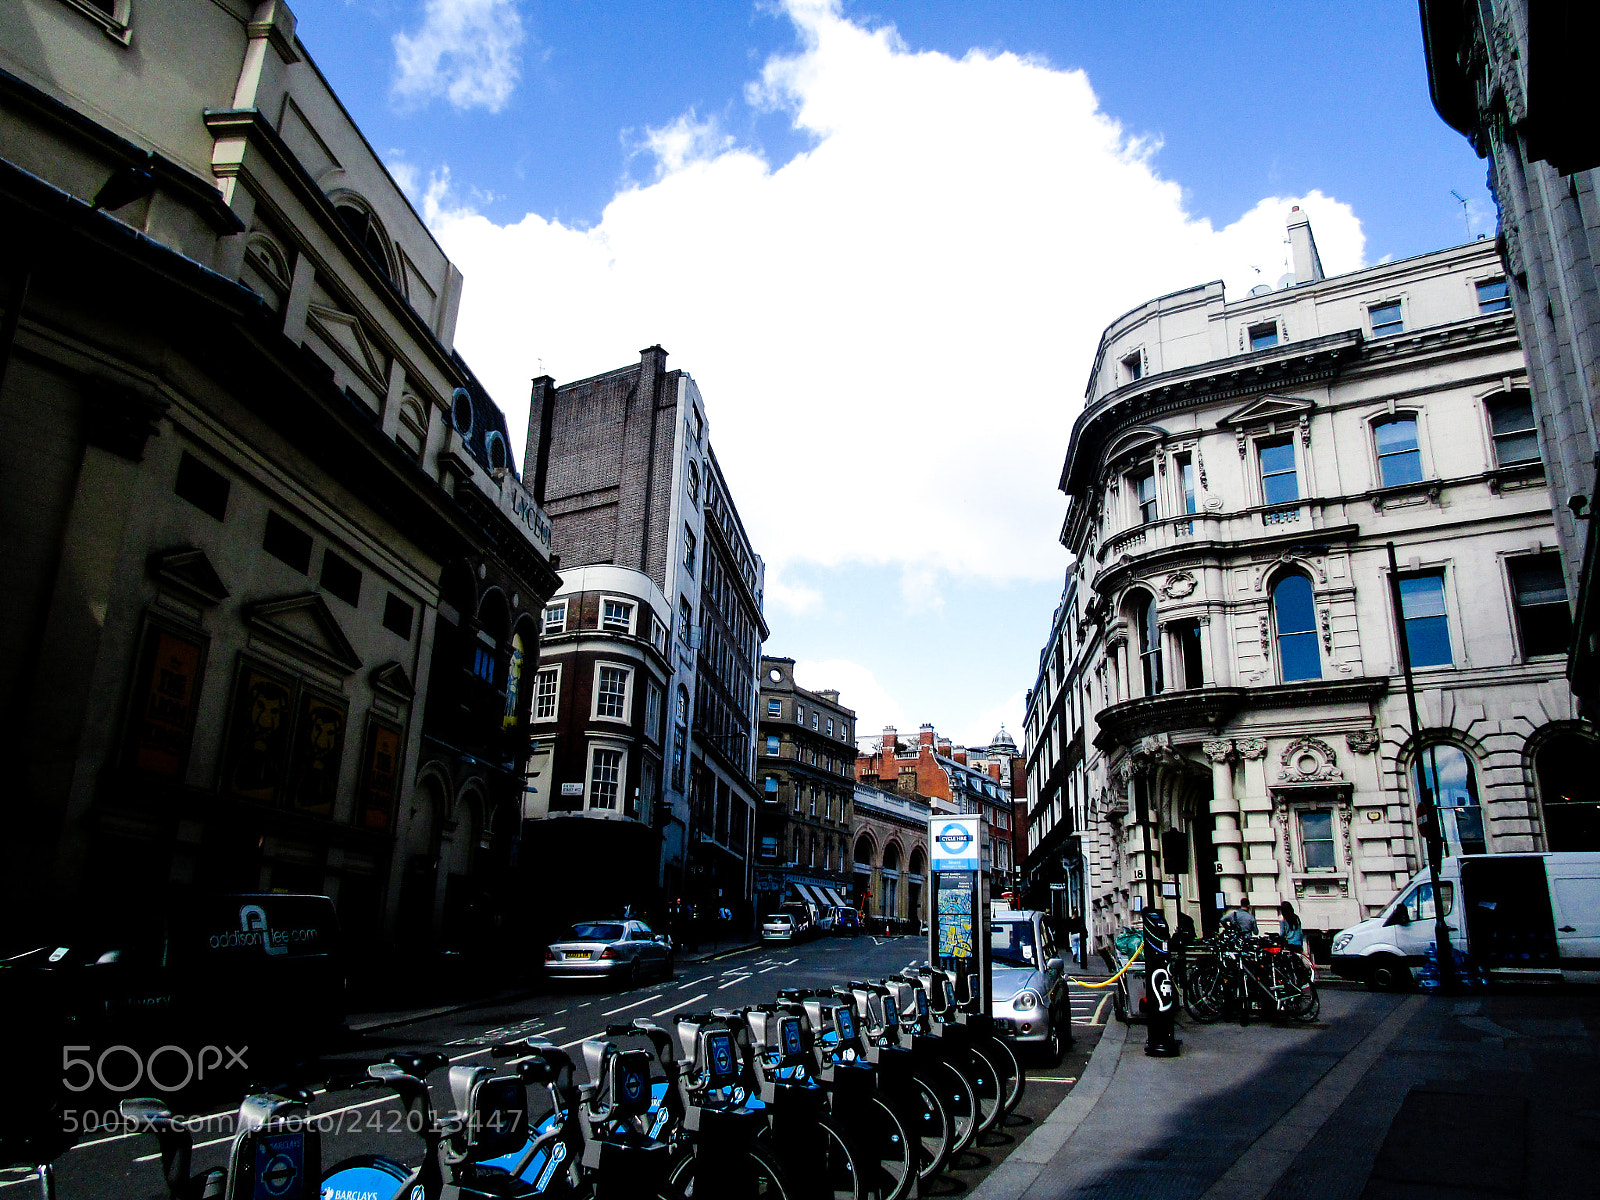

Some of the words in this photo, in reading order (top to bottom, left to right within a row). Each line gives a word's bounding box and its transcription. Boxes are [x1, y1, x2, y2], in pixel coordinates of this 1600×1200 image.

[1134, 869, 1143, 878] 18
[209, 930, 262, 949] addison
[334, 1189, 378, 1200] BARCLAYS
